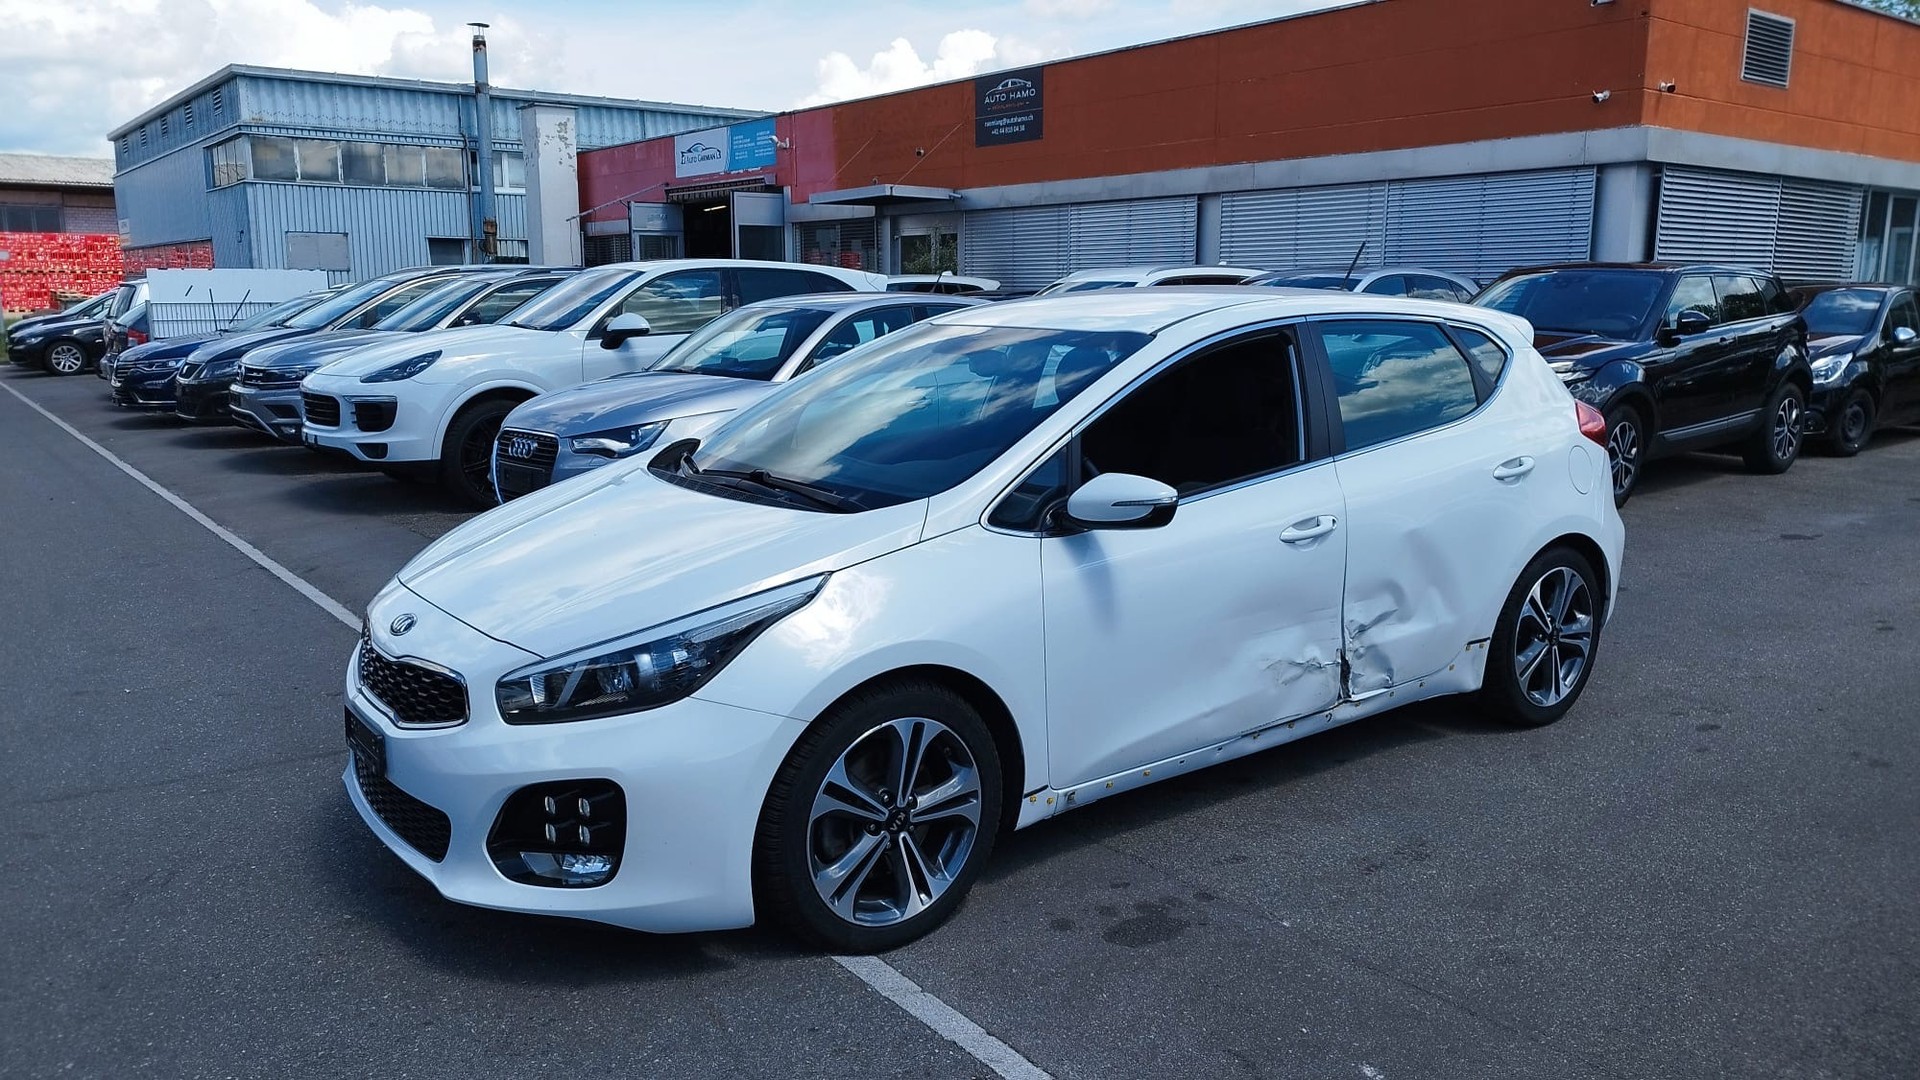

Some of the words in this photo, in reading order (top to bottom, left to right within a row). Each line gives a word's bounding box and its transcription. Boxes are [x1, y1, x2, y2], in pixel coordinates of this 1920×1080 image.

[984, 94, 1007, 104] AUTO
[1009, 88, 1036, 100] HAMO
[889, 812, 906, 831] KIA
